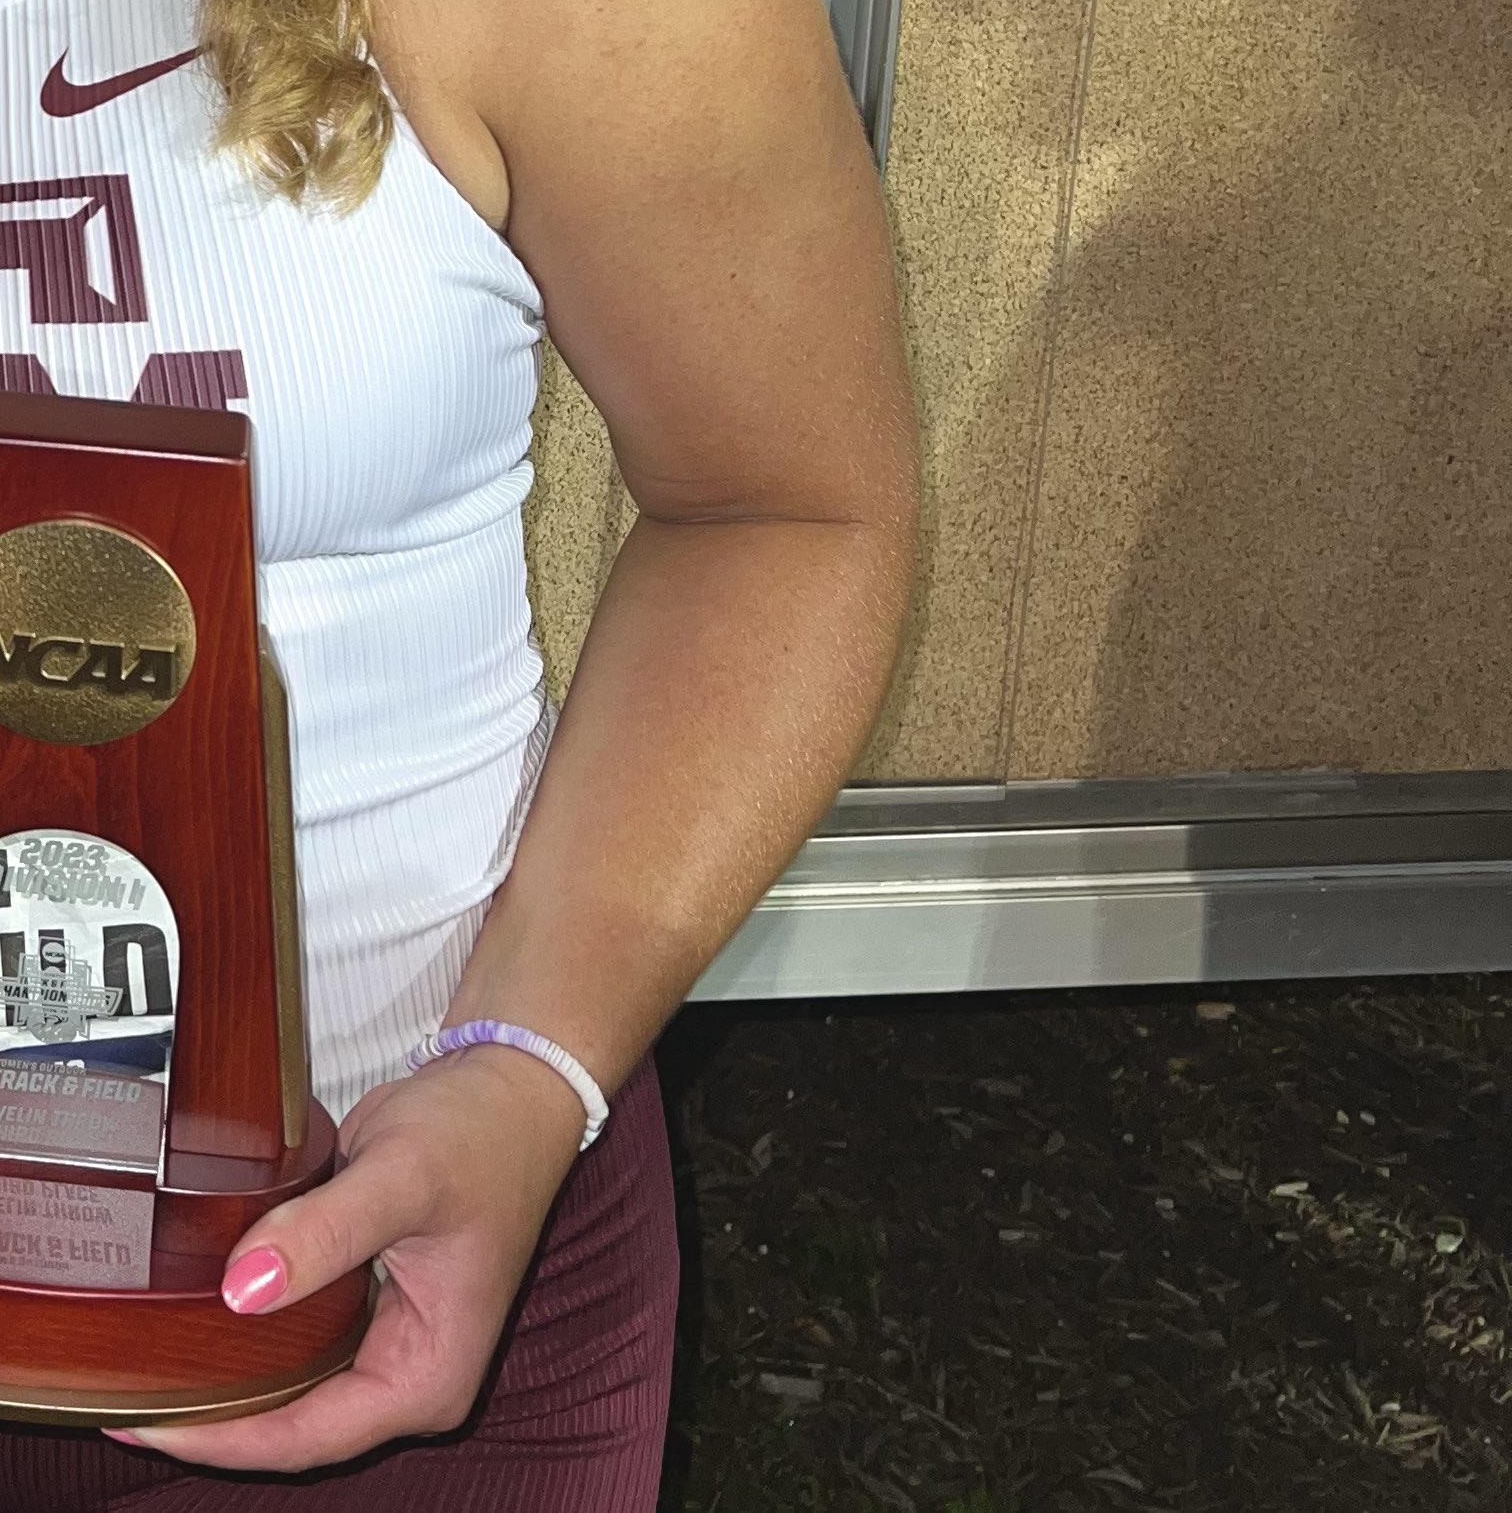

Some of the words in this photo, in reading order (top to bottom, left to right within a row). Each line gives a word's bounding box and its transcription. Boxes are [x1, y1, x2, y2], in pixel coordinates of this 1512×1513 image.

[20, 837, 110, 875] 2023
[62, 1075, 80, 1096] &
[81, 1078, 143, 1104] FIELD
